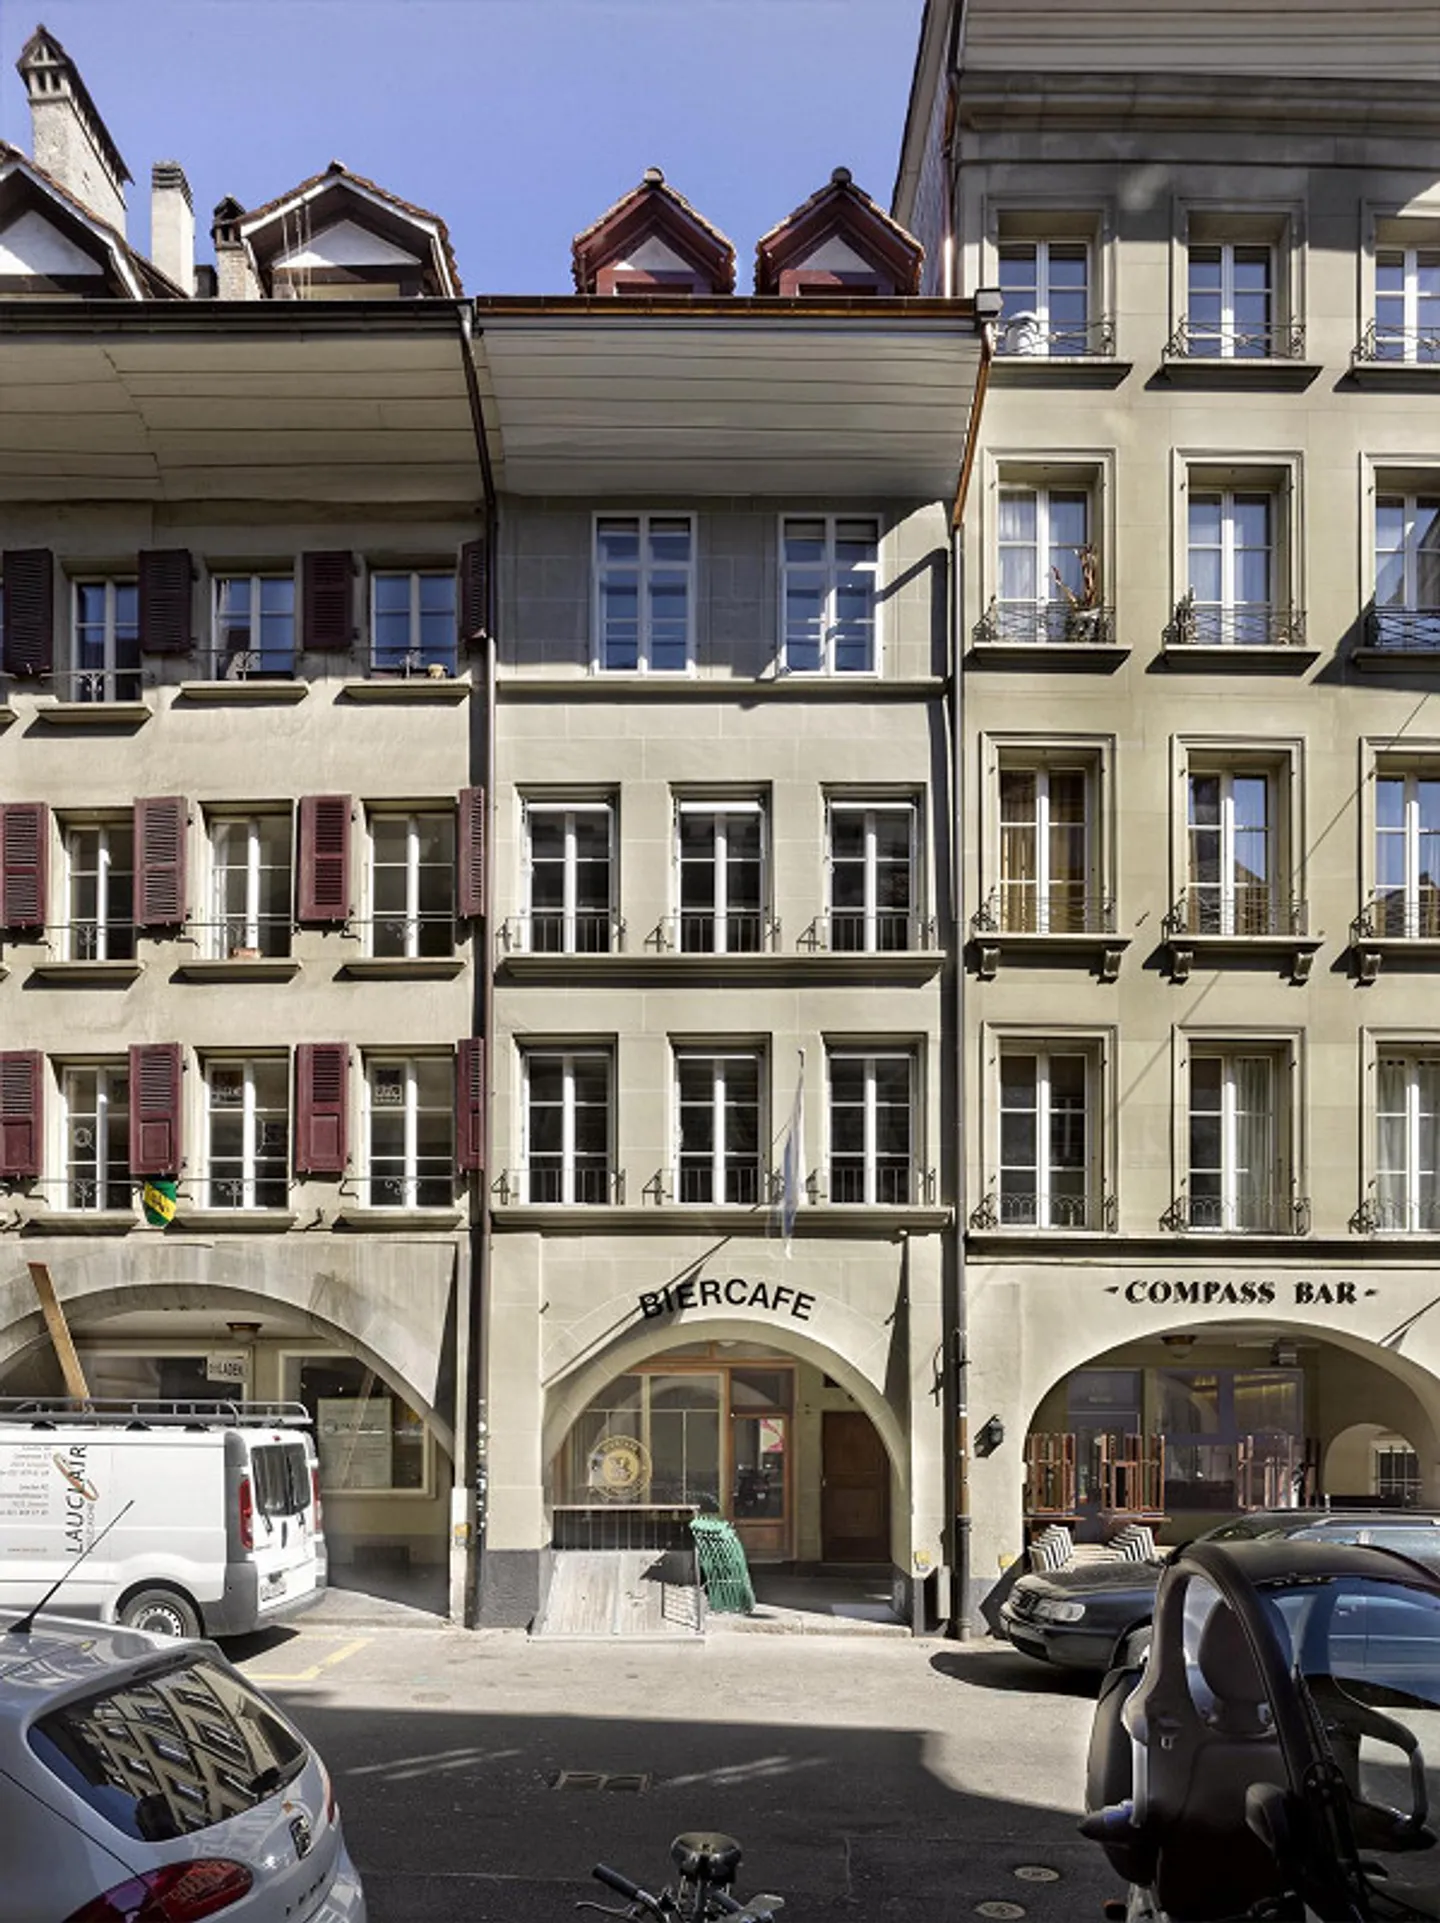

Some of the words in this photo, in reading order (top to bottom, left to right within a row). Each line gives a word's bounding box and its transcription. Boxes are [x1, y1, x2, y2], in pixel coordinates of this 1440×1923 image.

[639, 1278, 816, 1321] BIERCAFE
[1124, 1280, 1276, 1305] COMPASS
[1294, 1281, 1358, 1305] BAR
